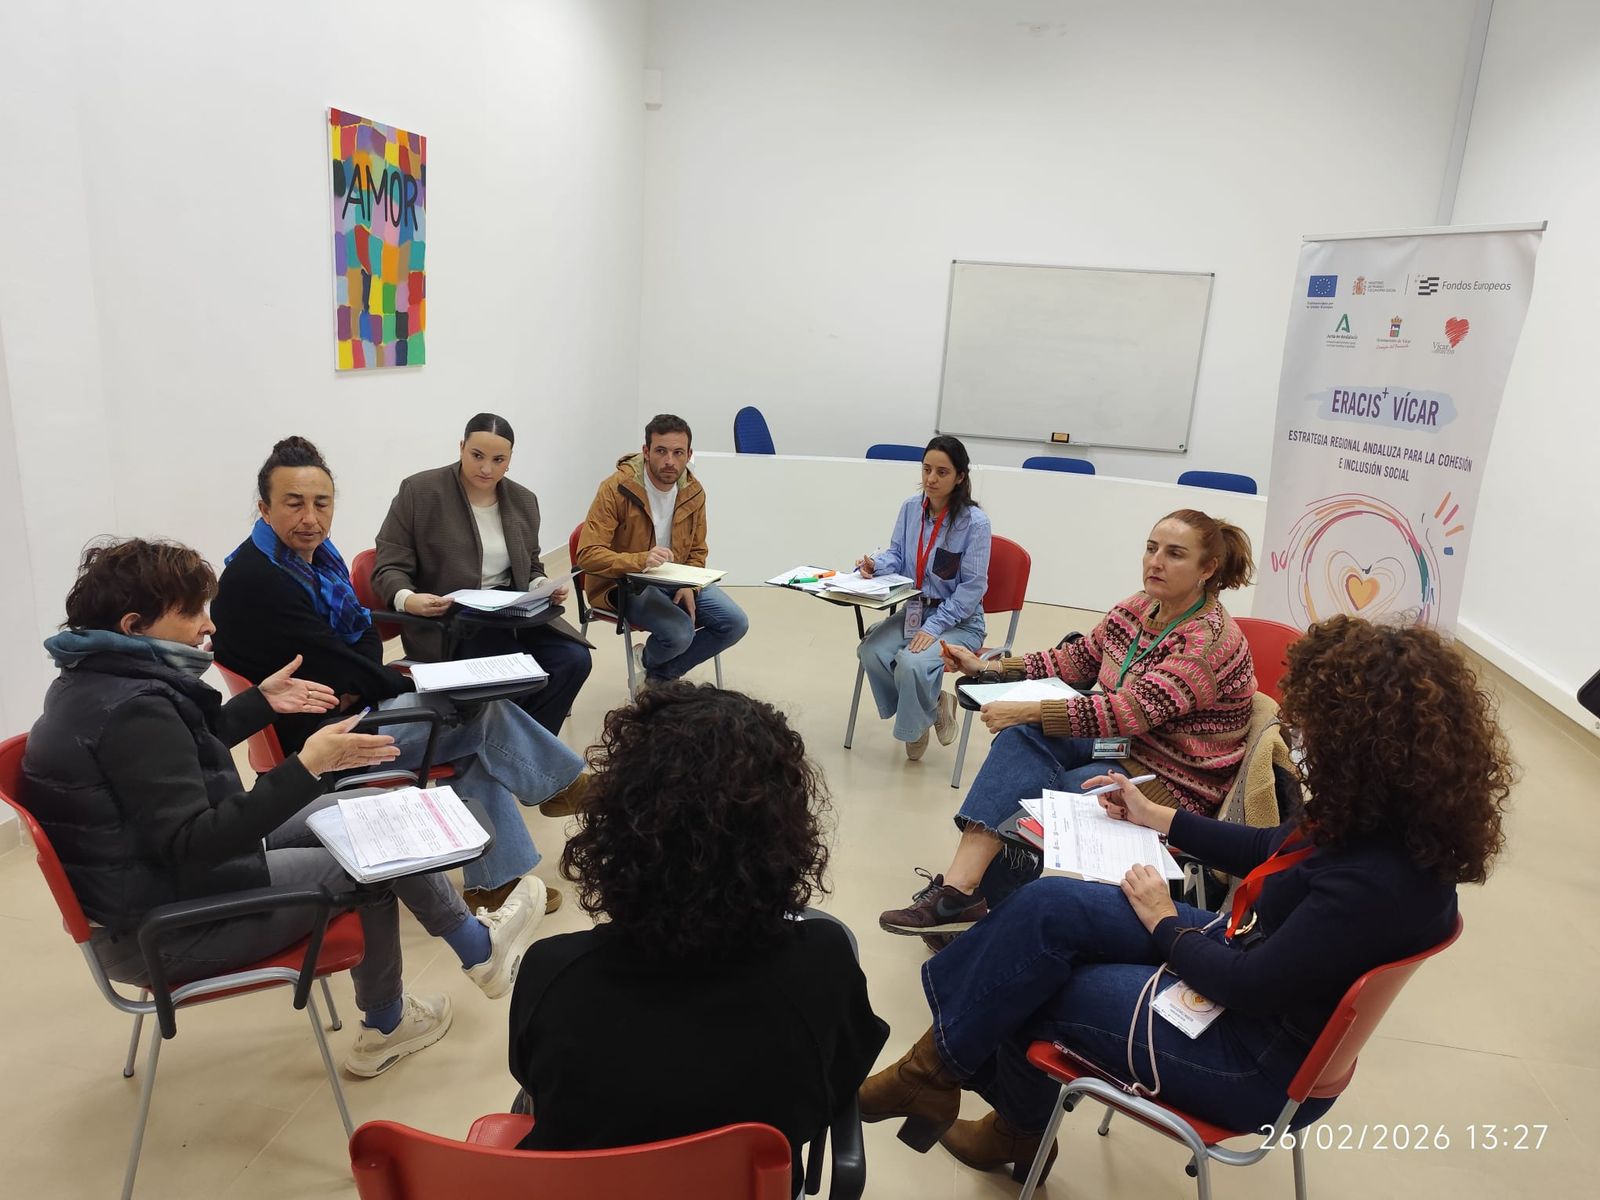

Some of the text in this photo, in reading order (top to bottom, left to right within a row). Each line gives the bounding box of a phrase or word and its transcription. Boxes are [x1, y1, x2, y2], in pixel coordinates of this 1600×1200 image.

[342, 162, 419, 231] AMOR
[1441, 280, 1511, 292] Fondos Europeos
[1393, 392, 1439, 426] VÍCAR
[1288, 430, 1472, 472] ESTRATEGIA REGIONAL ANDALUZA PARA LA COHESIÓN
[1338, 458, 1409, 482] E INCLUSIÓN SOCIAL
